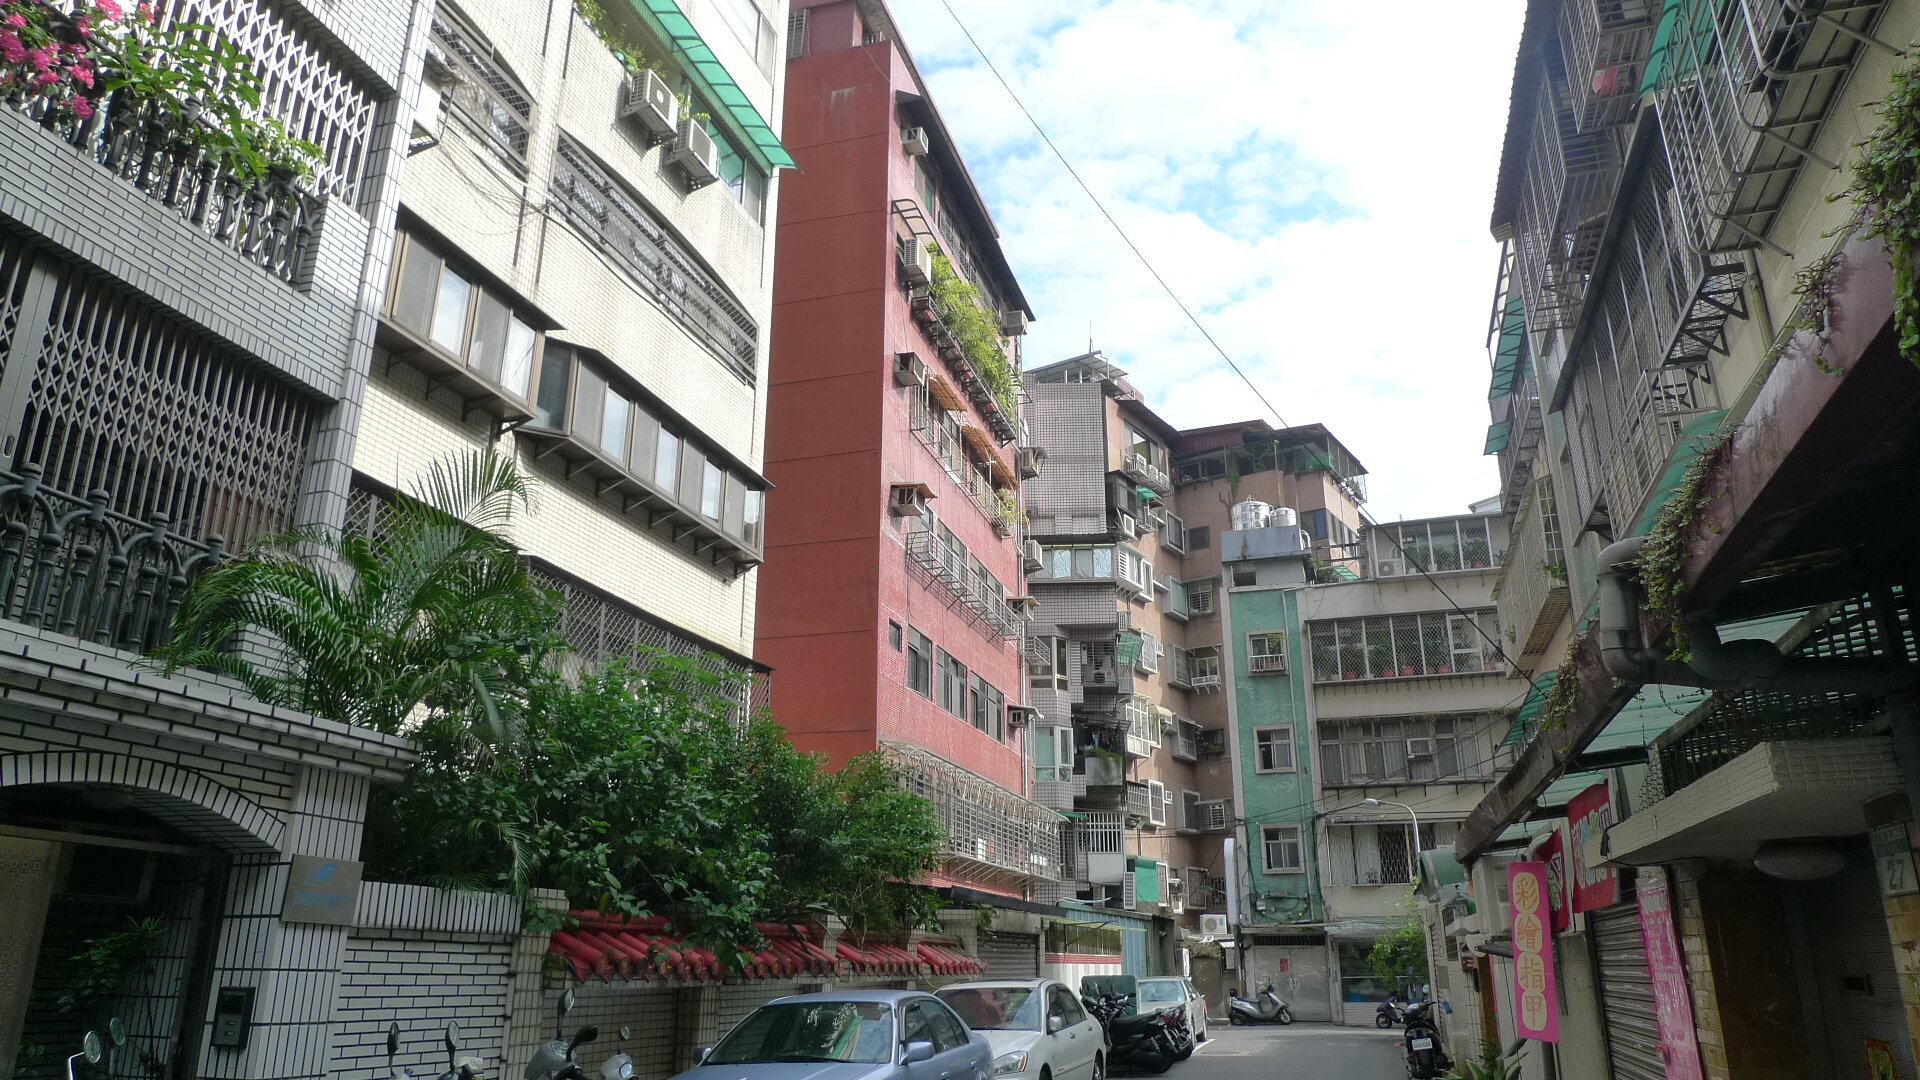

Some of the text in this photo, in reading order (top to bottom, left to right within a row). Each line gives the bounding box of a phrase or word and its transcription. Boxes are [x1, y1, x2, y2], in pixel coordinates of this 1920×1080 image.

[1887, 858, 1905, 890] 27
[1513, 875, 1544, 1029] 彩繪指甲
